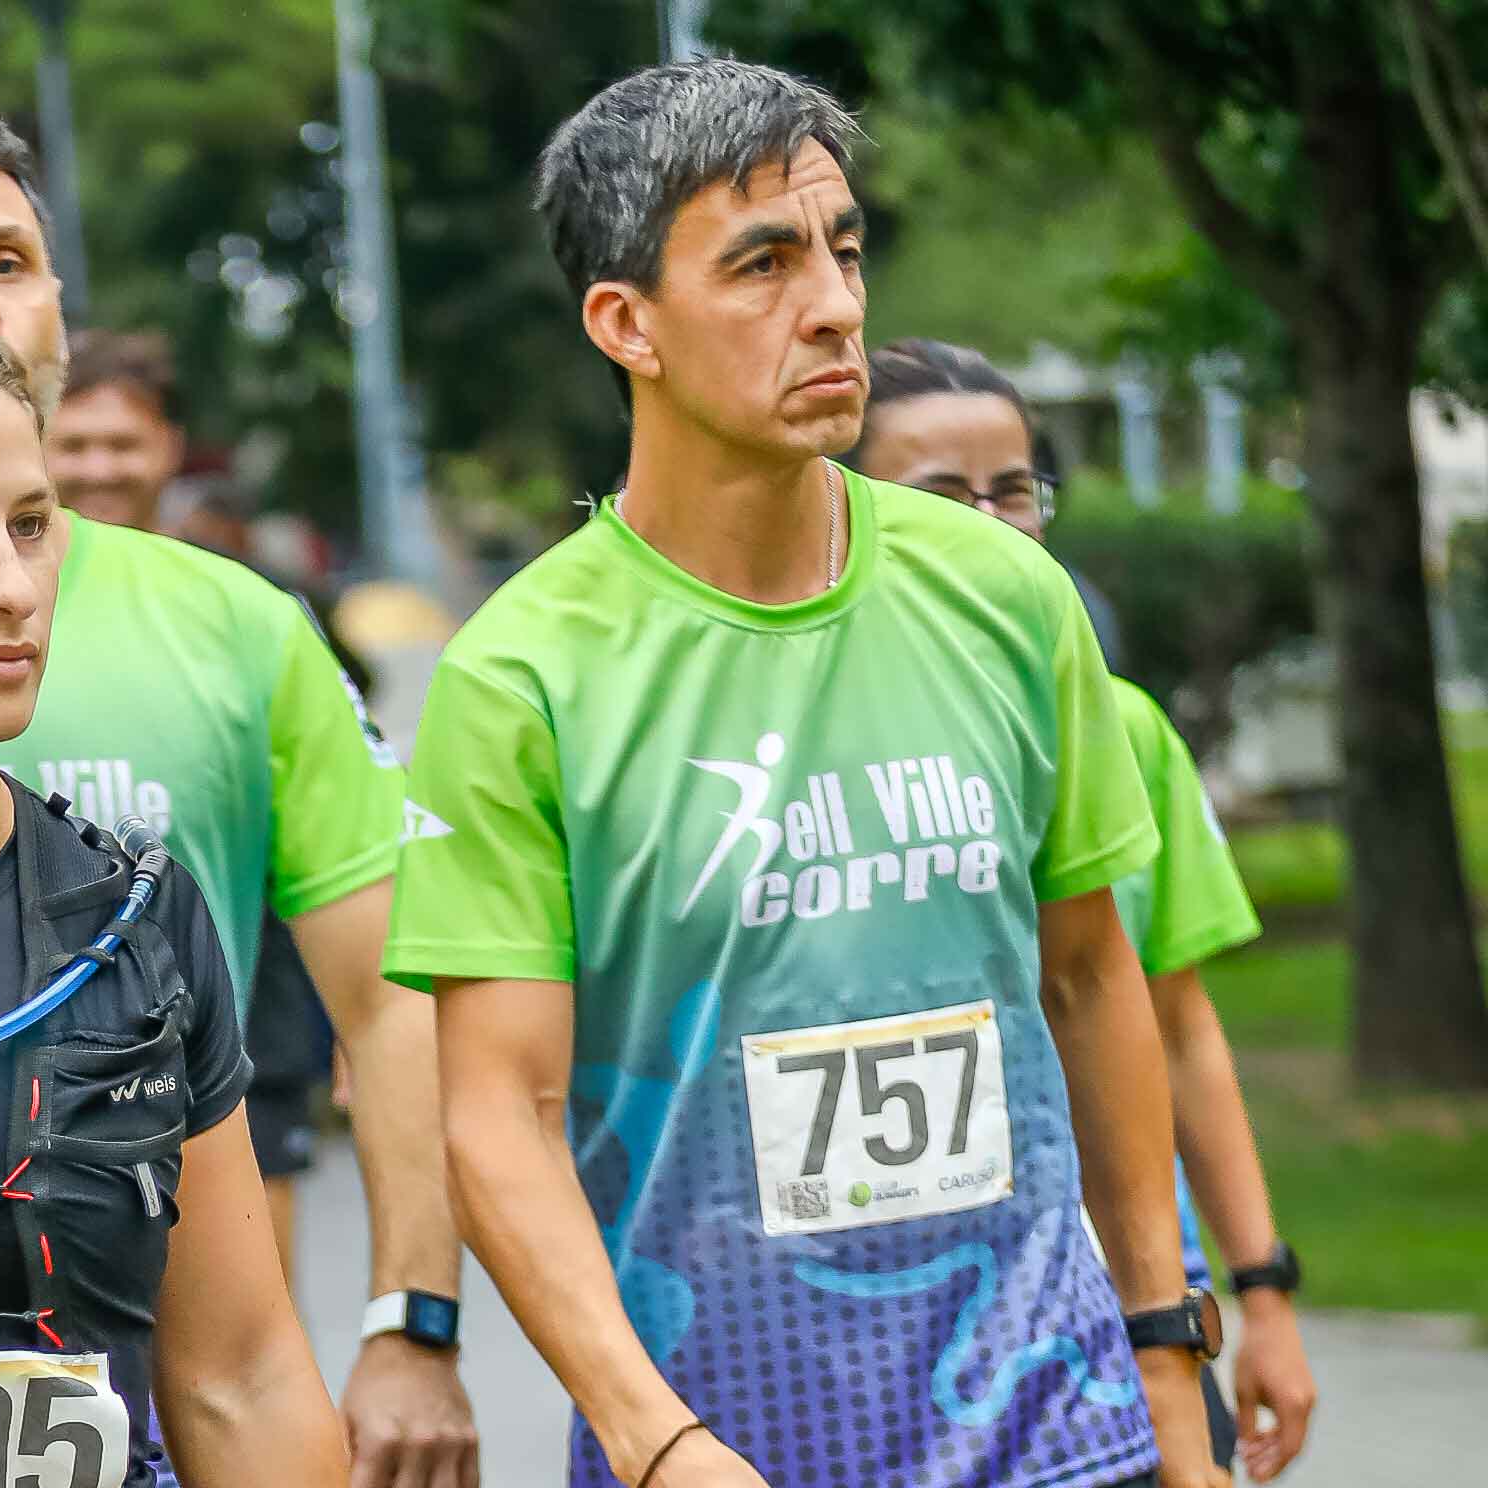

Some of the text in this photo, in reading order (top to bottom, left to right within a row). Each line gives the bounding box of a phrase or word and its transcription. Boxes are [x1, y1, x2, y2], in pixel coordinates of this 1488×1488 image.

[37, 759, 172, 838] Ville
[864, 755, 996, 844] Ville
[741, 839, 1001, 928] corre
[143, 1075, 176, 1096] weis
[776, 1028, 978, 1176] 757
